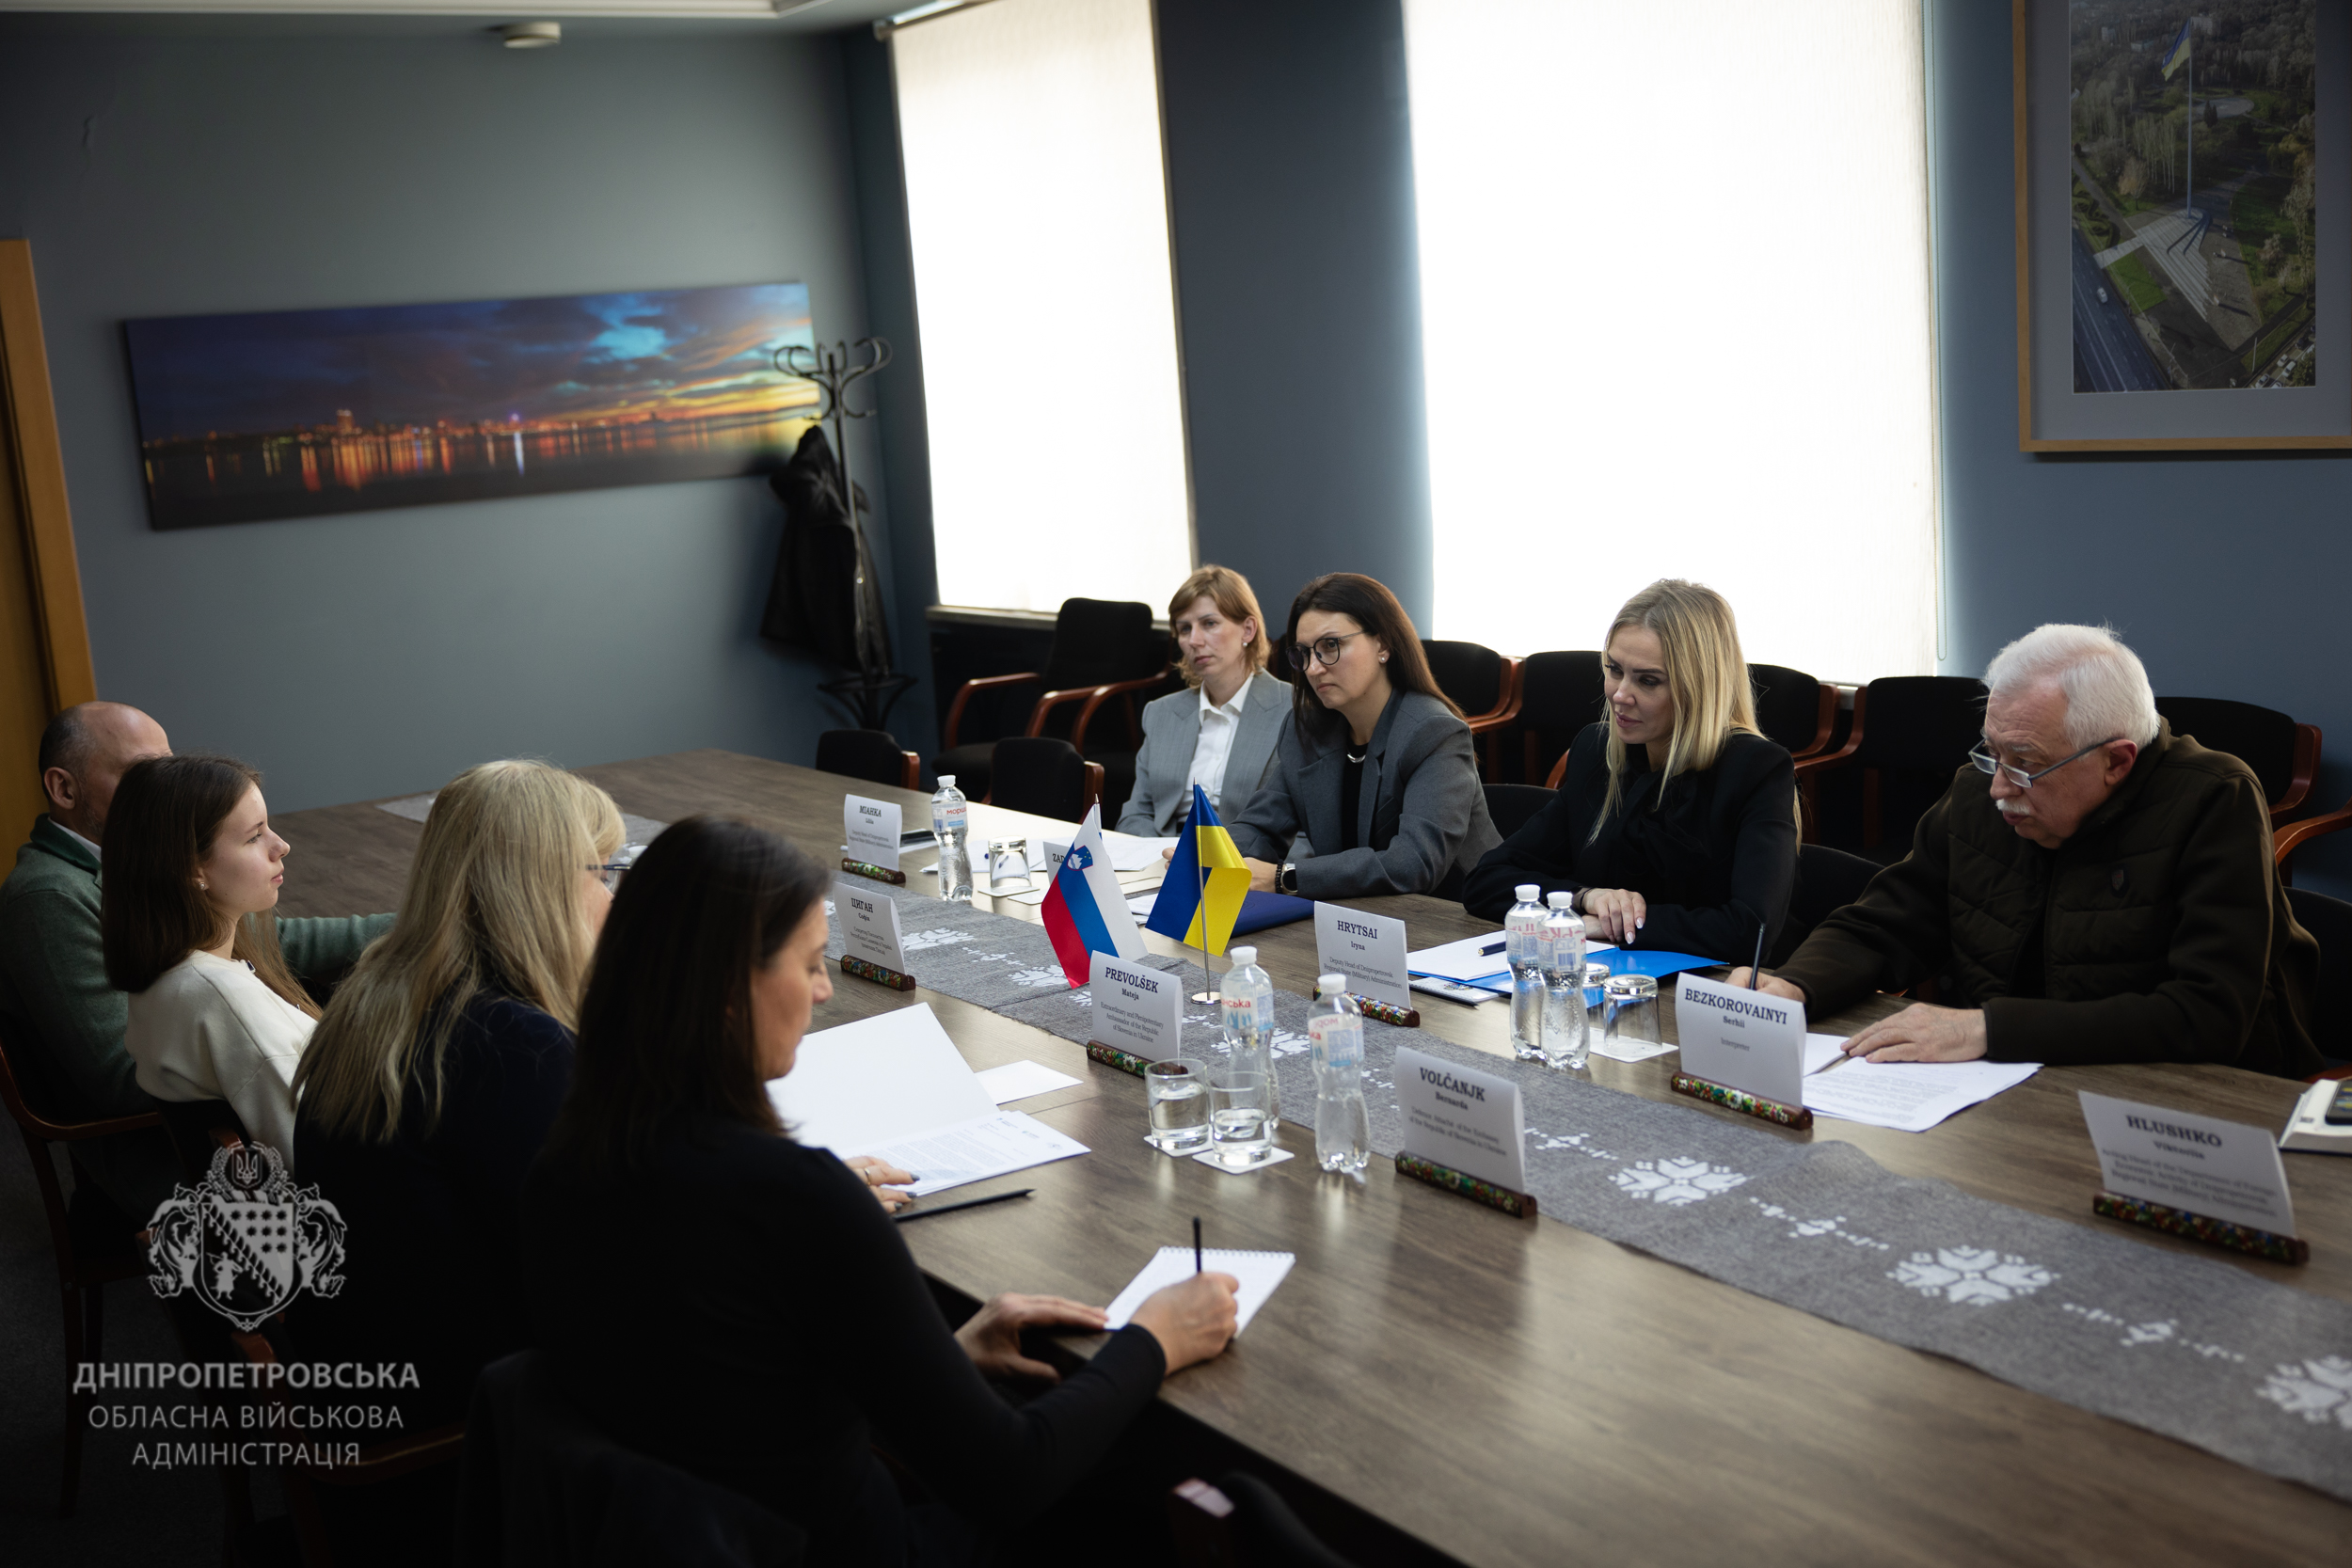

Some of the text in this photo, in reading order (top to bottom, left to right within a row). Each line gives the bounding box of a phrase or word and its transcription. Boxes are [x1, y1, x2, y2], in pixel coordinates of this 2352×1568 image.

[1337, 920, 1377, 940] HRYTSAI
[1350, 941, 1365, 951] Iryna
[1329, 957, 1344, 968] Deputy
[1344, 960, 1355, 969] Head
[1104, 966, 1159, 994] PREVOLŠEK
[1324, 963, 1341, 974] Regional
[1341, 967, 1351, 976] State
[1370, 976, 1402, 990] Administration
[1121, 988, 1139, 1001] Mateja
[1684, 988, 1788, 1025] BEZKOROVAINYI
[1723, 1015, 1745, 1028] Serhii
[1420, 1066, 1486, 1102] VOLČANJK
[1435, 1091, 1469, 1111] Bernarda
[2125, 1115, 2222, 1148] HLUSHKO
